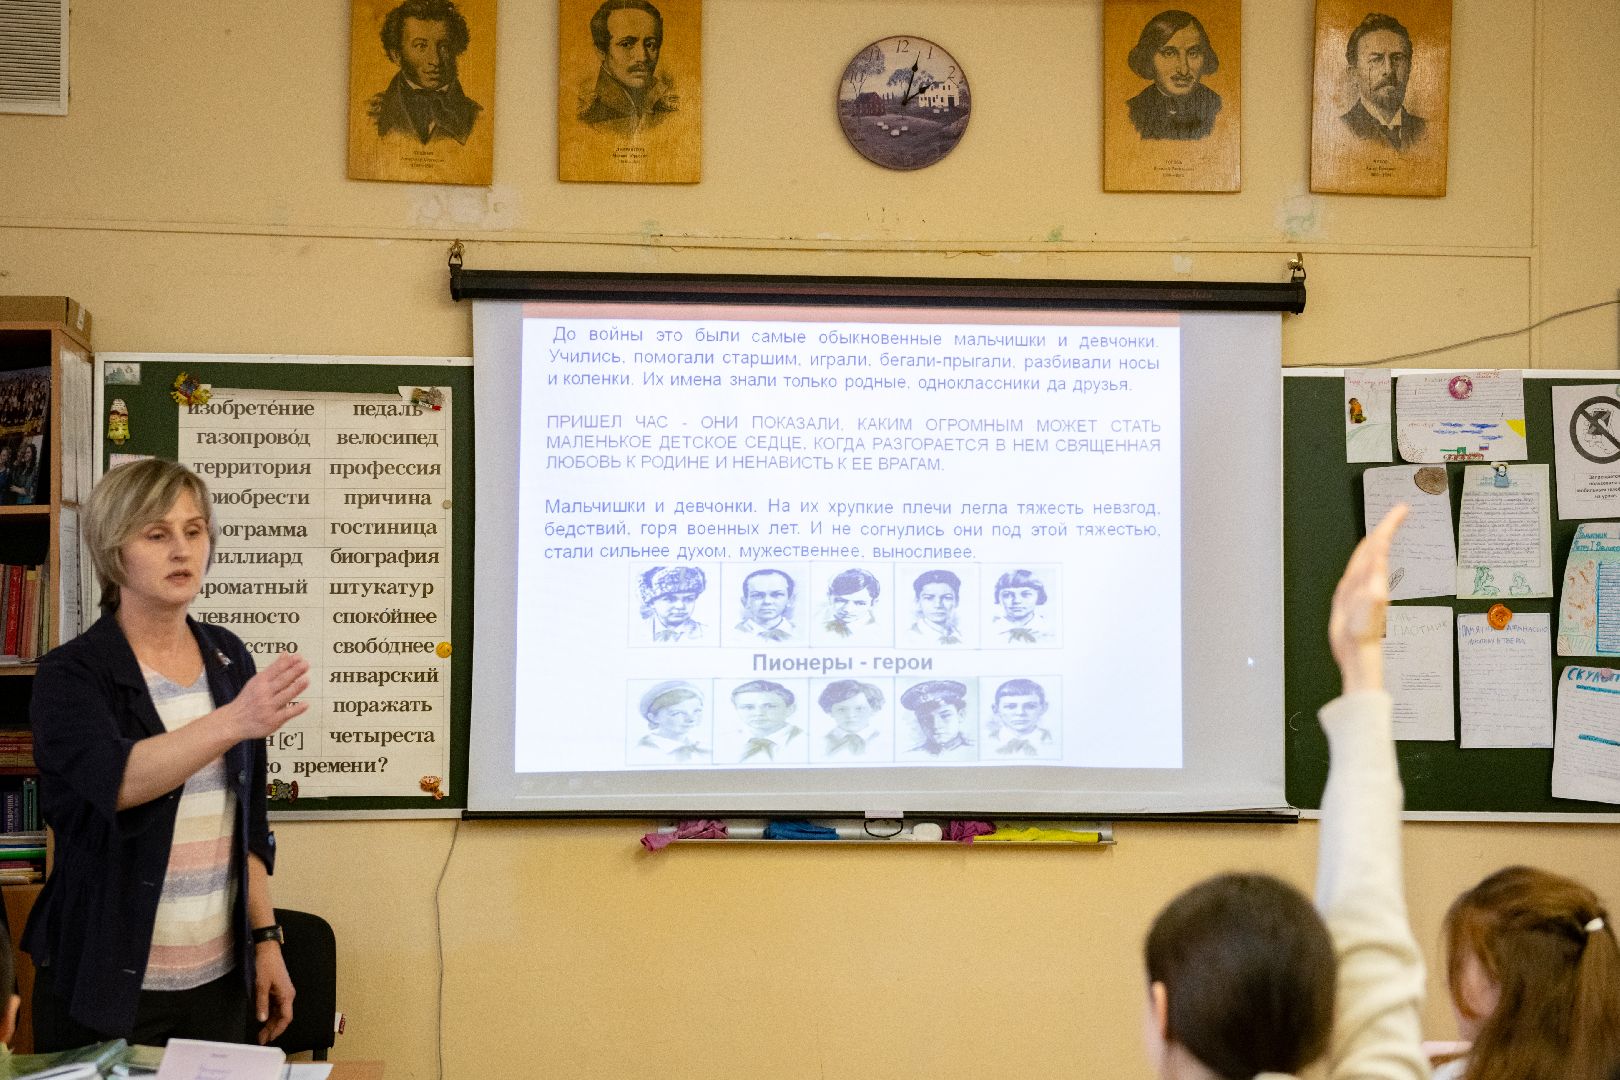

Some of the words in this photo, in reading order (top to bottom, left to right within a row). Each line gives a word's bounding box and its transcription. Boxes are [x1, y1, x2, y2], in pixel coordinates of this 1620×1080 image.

[896, 40, 909, 53] 12
[927, 46, 936, 59] 1
[947, 65, 956, 79] 2
[553, 326, 576, 344] До
[589, 326, 643, 342] войны
[656, 329, 684, 342] это
[695, 328, 739, 344] были
[752, 331, 807, 343] самые
[818, 330, 942, 345] обыкновенные
[954, 335, 1046, 347] мальчишки
[1058, 336, 1067, 347] и
[1079, 336, 1159, 350] девчонки.
[632, 352, 714, 364] помогали
[1024, 355, 1111, 372] разбивали
[1119, 358, 1159, 370] носы
[547, 374, 558, 385] и
[563, 373, 634, 386] коленки.
[643, 371, 664, 386] Их
[670, 375, 722, 386] имена
[730, 376, 776, 387] знали
[783, 376, 838, 388] только
[918, 377, 1040, 392] одноклассники
[1047, 379, 1066, 392] да
[1073, 380, 1132, 394] друзья.
[353, 404, 423, 418] педаль
[547, 415, 622, 429] ПРИШЕЛ
[636, 415, 668, 431] ЧАС
[701, 416, 738, 429] ОНИ
[858, 417, 912, 431] КАКИМ
[923, 418, 1023, 432] ОГРОМНЫМ
[1037, 419, 1098, 432] МОЖЕТ
[1111, 420, 1161, 432] СТАТЬ
[337, 433, 438, 447] велосипед
[546, 435, 652, 448] МАЛЕНЬКОЕ
[659, 435, 738, 451] ДЕТСКОЕ
[814, 437, 866, 453] КОГДА
[872, 437, 988, 451] РАЗГОРАЕТСЯ
[996, 438, 1006, 451] В
[1011, 438, 1048, 452] НЕМ
[1056, 439, 1160, 455] СВЯЩЕННАЯ
[193, 462, 311, 478] территория
[329, 461, 441, 479] профессия
[546, 455, 621, 469] ЛЮБОВЬ
[627, 455, 637, 468] К
[641, 455, 710, 471] РОДИНЕ
[716, 456, 727, 469] И
[733, 456, 833, 470] НЕНАВИСТЬ
[838, 457, 847, 470] К
[852, 457, 872, 470] ЕЕ
[879, 456, 944, 471] ВРАГАМ.
[344, 493, 432, 509] причина
[545, 499, 645, 514] Мальчишки
[655, 502, 664, 512] и
[674, 501, 757, 515] девчонки.
[768, 498, 790, 512] На
[801, 502, 819, 513] их
[828, 502, 893, 518] хрупкие
[902, 503, 951, 514] плечи
[961, 504, 1008, 515] легла
[1017, 504, 1084, 515] тяжесть
[219, 524, 308, 540] ограмма
[331, 522, 437, 537] гостиница
[640, 523, 678, 539] горя
[688, 520, 759, 535] военных
[768, 522, 800, 535] лет.
[810, 521, 822, 535] И
[832, 524, 851, 536] не
[860, 525, 944, 540] согнулись
[952, 525, 982, 536] они
[992, 525, 1021, 539] под
[1031, 522, 1067, 536] этой
[213, 552, 303, 568] иллиард
[330, 548, 439, 567] биография
[544, 545, 593, 559] стали
[600, 545, 670, 559] сильнее
[872, 547, 976, 560] выносливее.
[329, 582, 434, 598] штукатур
[244, 642, 298, 654] сство
[753, 654, 853, 672] Пионеры
[873, 657, 933, 673] герои
[329, 667, 439, 686] январский
[332, 700, 432, 716] поражать
[329, 730, 435, 747] четыреста
[293, 757, 388, 777] времени?
